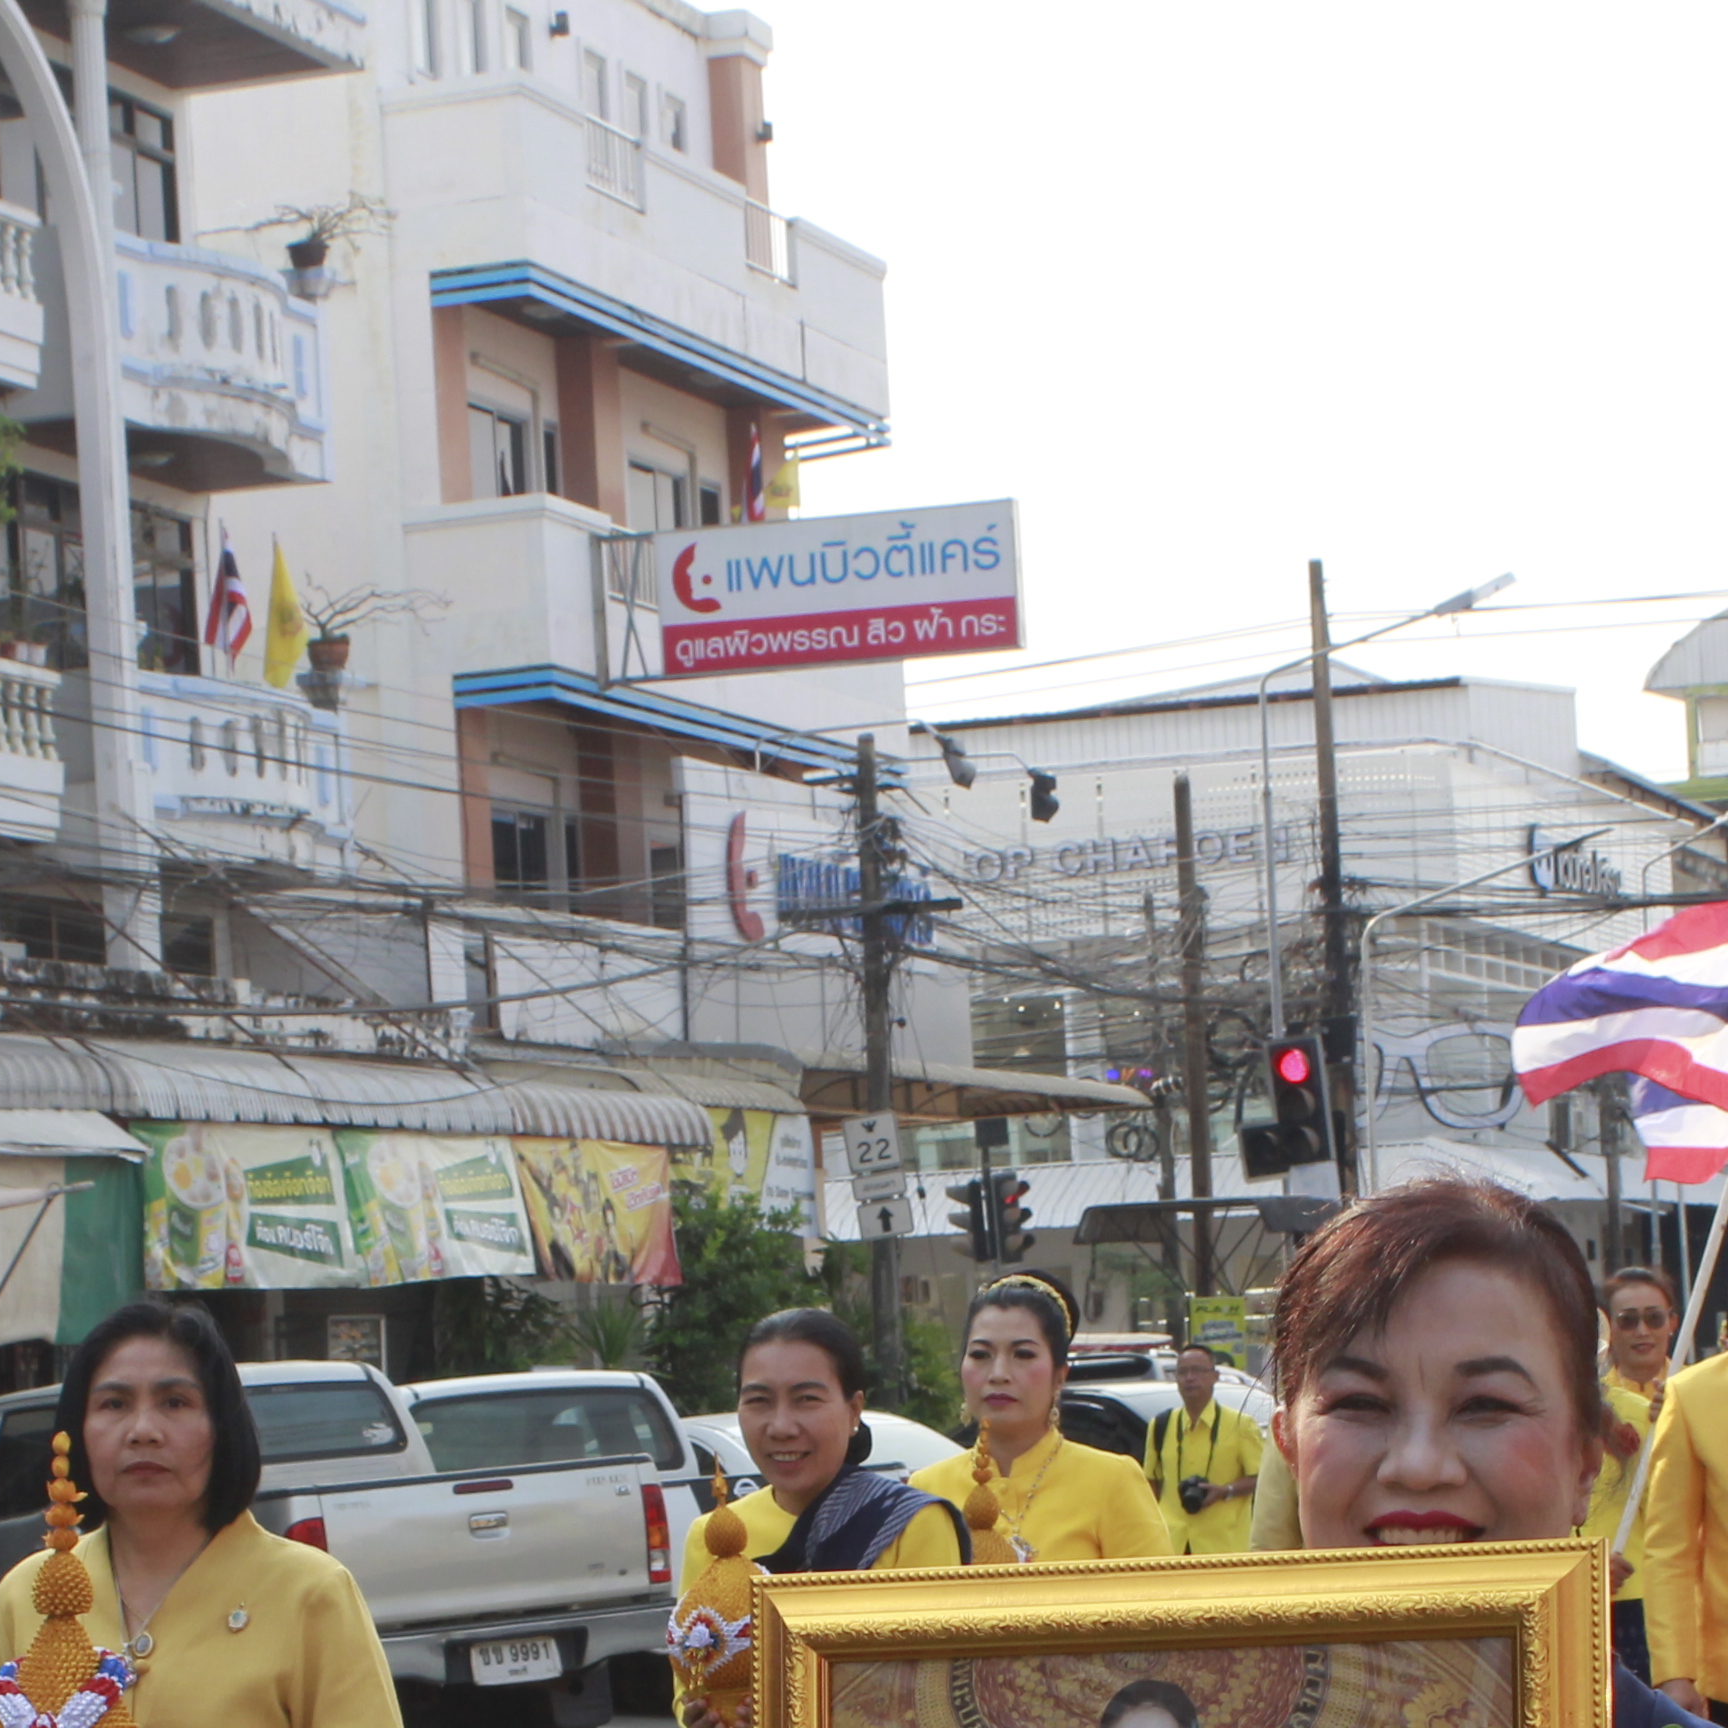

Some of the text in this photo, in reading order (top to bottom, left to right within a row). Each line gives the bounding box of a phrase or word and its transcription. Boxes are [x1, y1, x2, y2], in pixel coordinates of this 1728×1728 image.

[726, 521, 1002, 593] แพนบิวตี้แคร์
[675, 607, 1008, 668] ดูแลผิวพรรณ สิว ฝ้า กระ
[856, 1137, 892, 1164] 22
[509, 1641, 550, 1663] 9991
